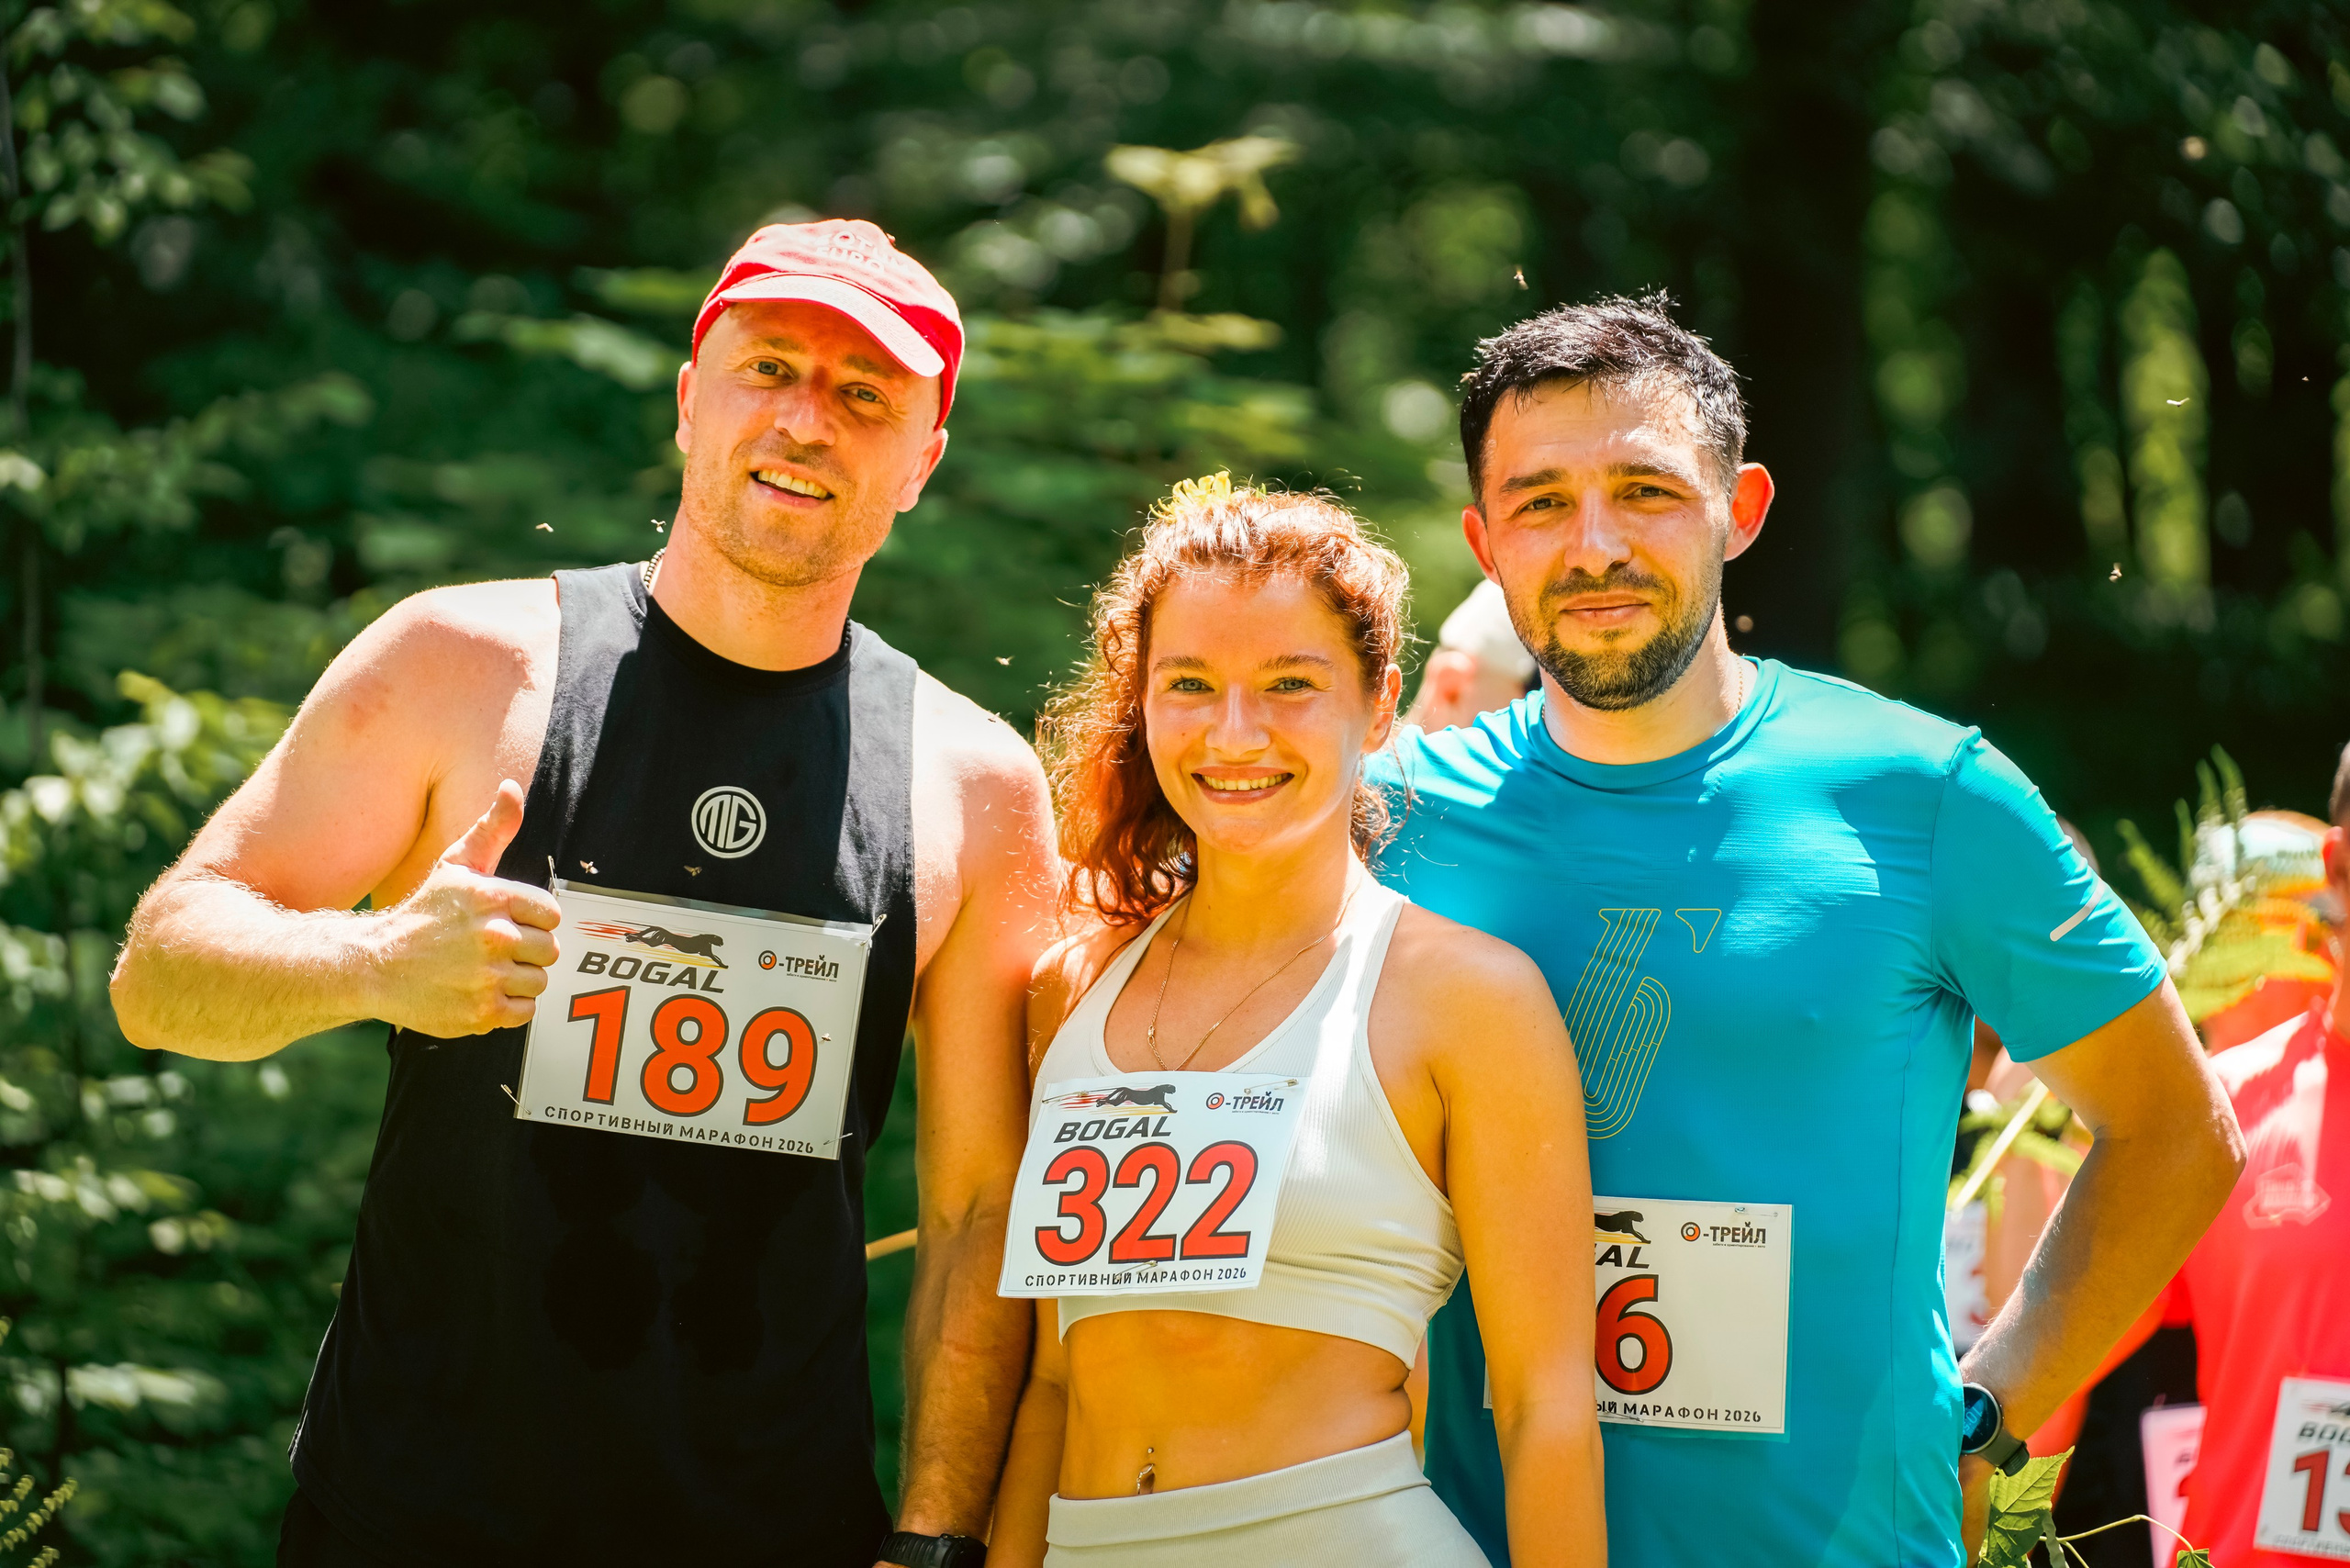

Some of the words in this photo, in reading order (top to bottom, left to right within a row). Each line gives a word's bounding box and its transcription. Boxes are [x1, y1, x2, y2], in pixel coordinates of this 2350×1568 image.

[576, 951, 730, 994] BOGAL
[567, 985, 818, 1126] 189
[544, 1105, 674, 1136] СПОРТИВНЫЙ
[679, 1128, 773, 1149] МАРАФОН
[778, 1138, 814, 1154] 2026
[1054, 1116, 1172, 1144] BOGAL
[1035, 1140, 1259, 1266] 322
[1025, 1272, 1132, 1287] СПОРТИВНЫЙ
[1136, 1269, 1213, 1284] МАРАФОН
[1217, 1268, 1247, 1281] 2026
[1595, 1273, 1673, 1395] 6
[1623, 1402, 1718, 1421] МАРАФОН
[1724, 1409, 1762, 1423] 2026
